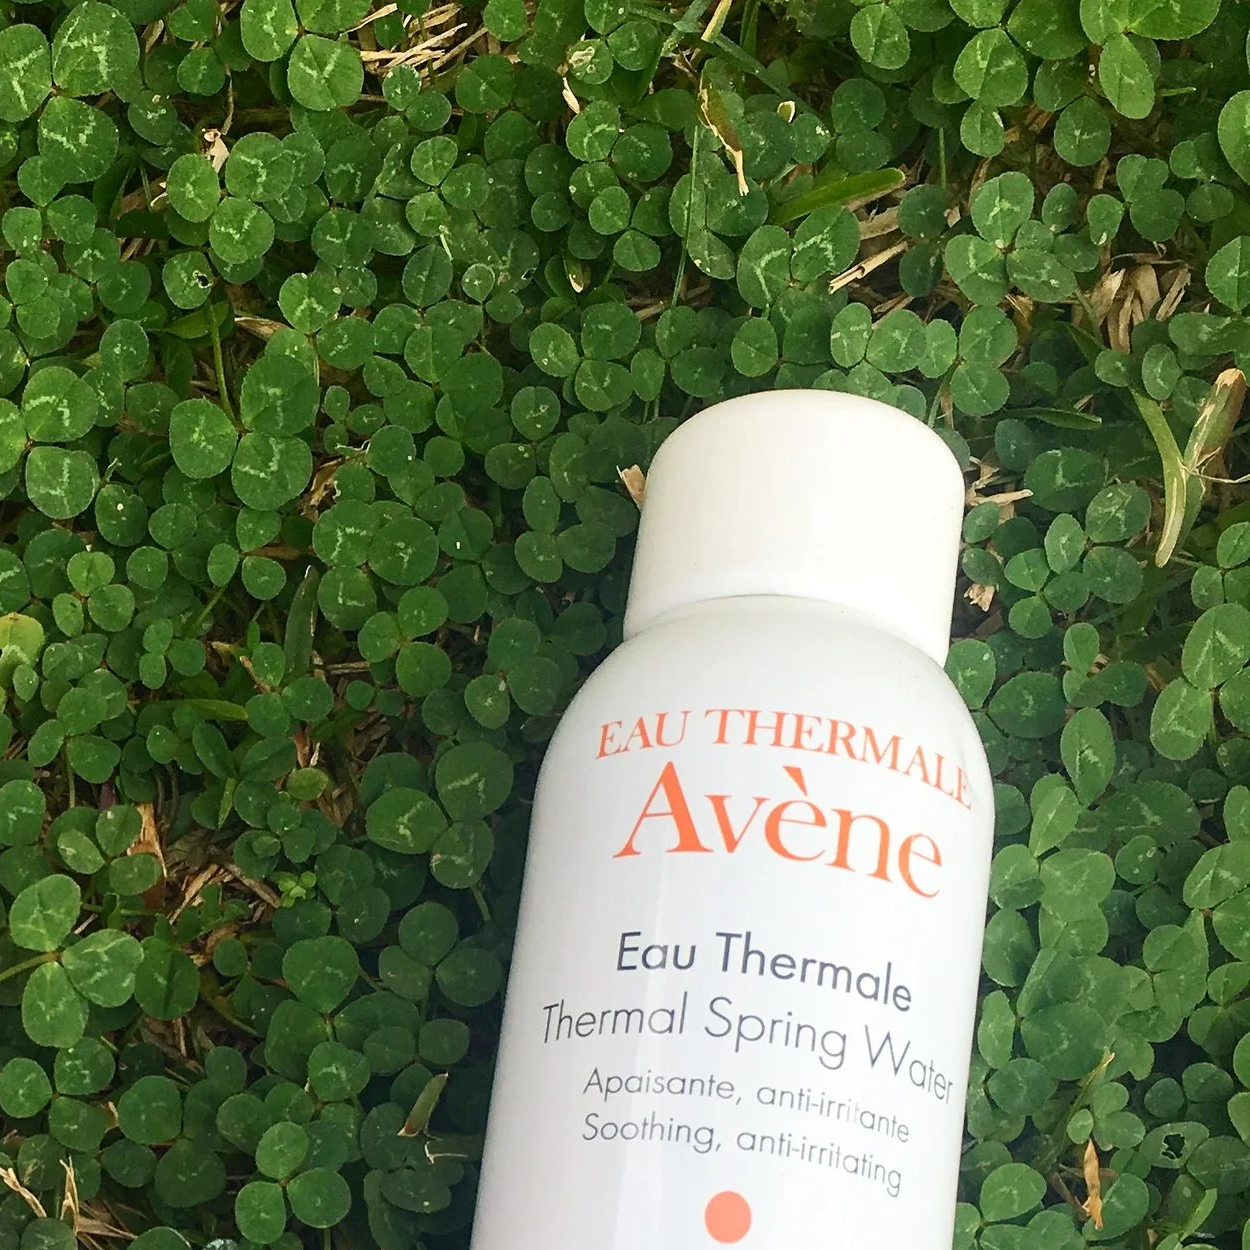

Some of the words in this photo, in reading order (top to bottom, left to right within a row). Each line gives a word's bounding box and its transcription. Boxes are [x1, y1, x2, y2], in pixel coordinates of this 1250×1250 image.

[595, 709, 691, 761] EAU
[704, 708, 974, 811] THERMALE
[612, 760, 944, 900] Avène
[616, 931, 696, 972] Eau
[716, 930, 914, 1013] Thermale
[543, 990, 688, 1044] Thermal
[704, 996, 848, 1070] Spring
[864, 1024, 954, 1105] Water
[583, 1067, 742, 1106] Apaisante,
[756, 1083, 911, 1144] anti-irritante
[582, 1111, 722, 1154] Soothing,
[736, 1130, 903, 1199] anti-irritating
